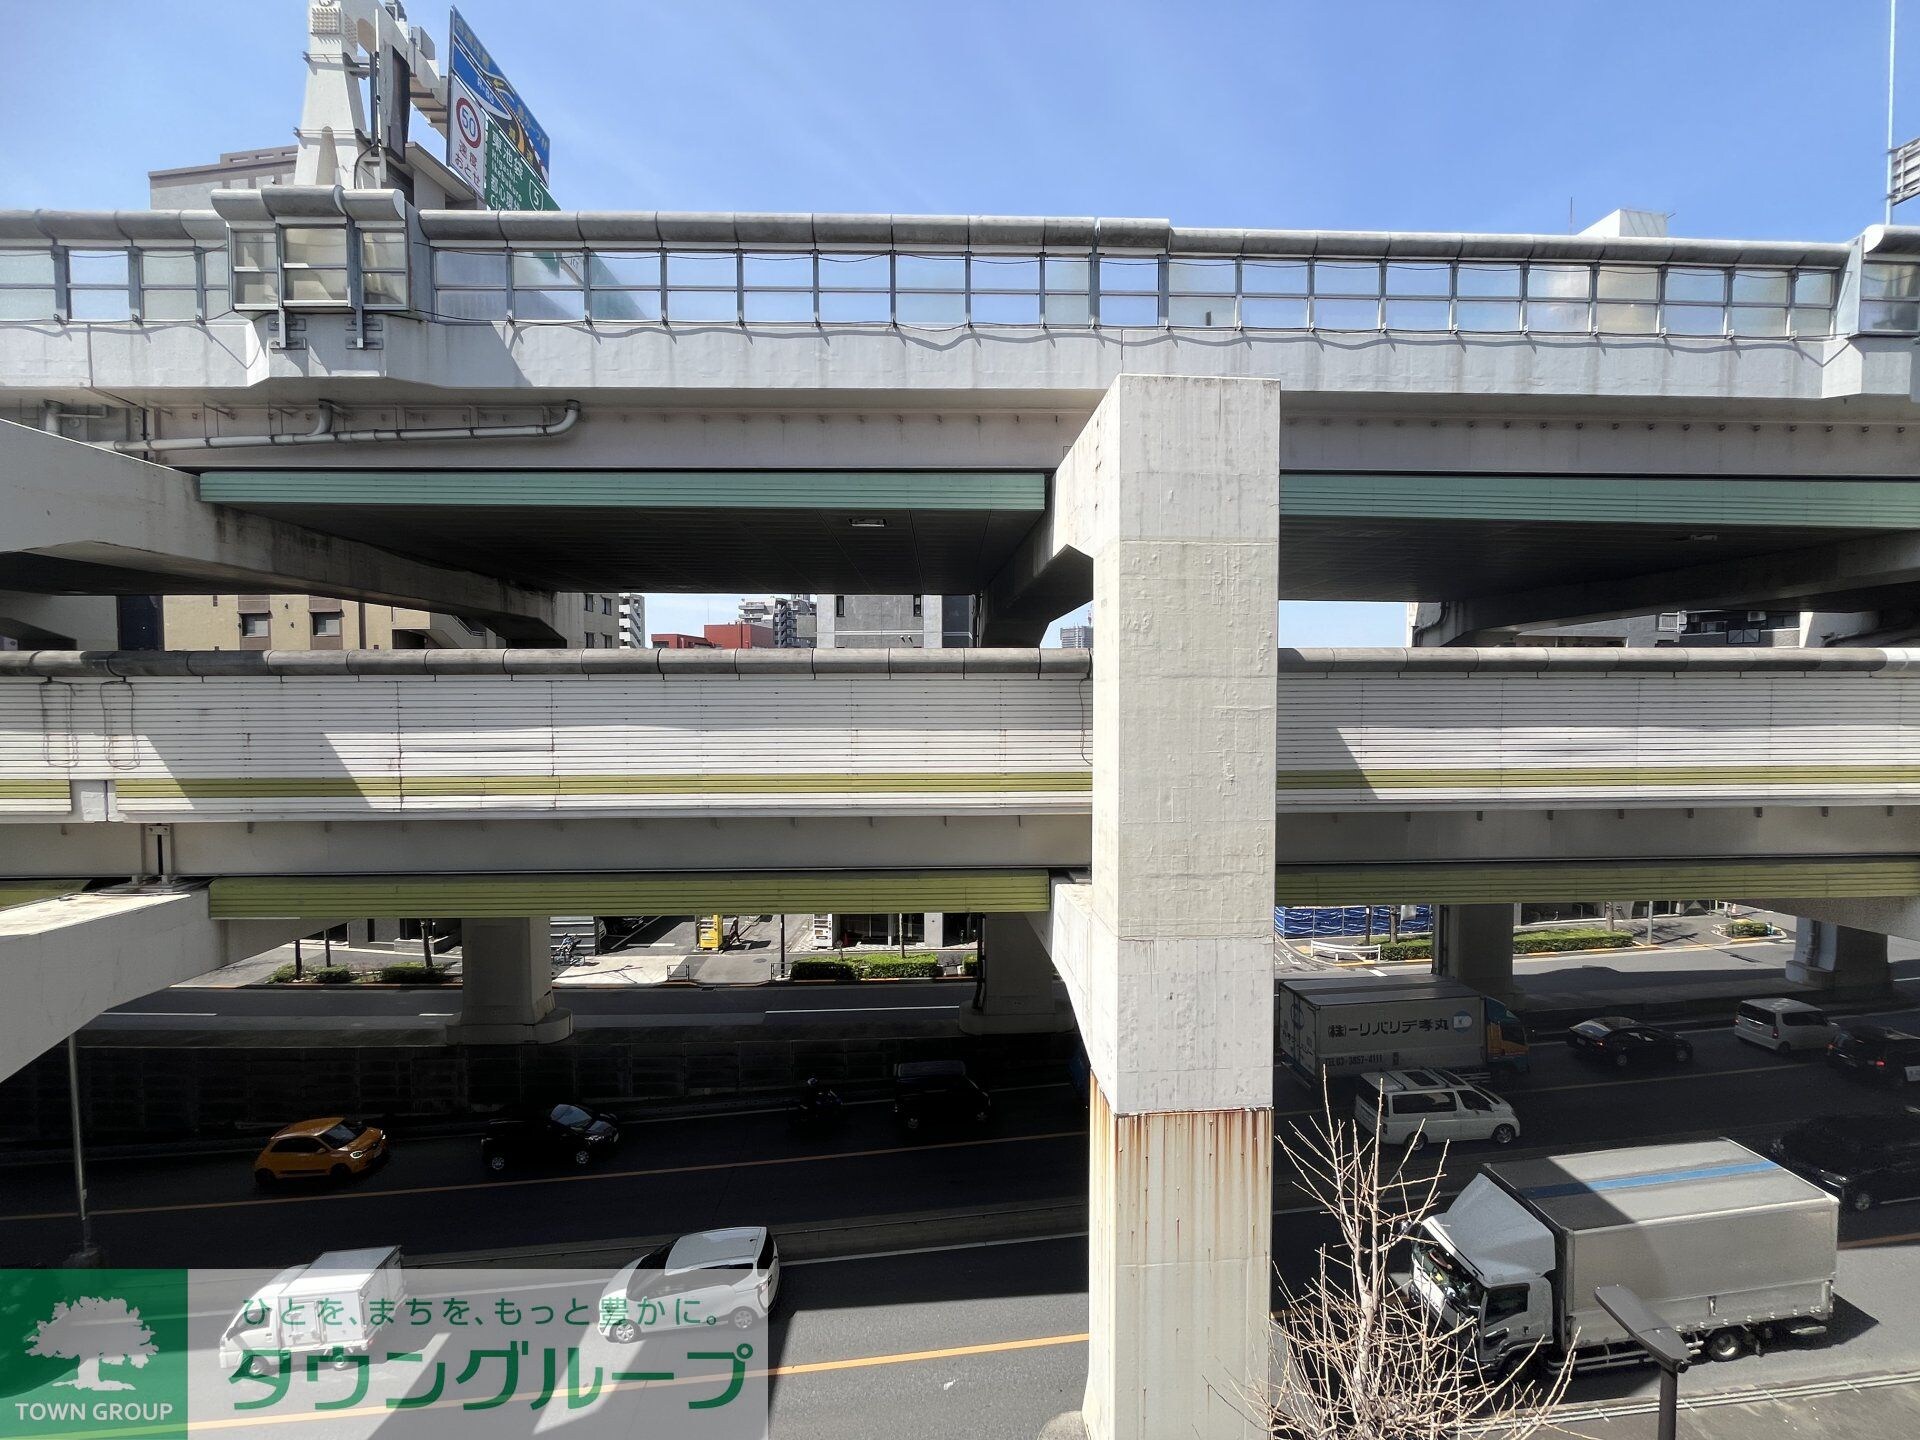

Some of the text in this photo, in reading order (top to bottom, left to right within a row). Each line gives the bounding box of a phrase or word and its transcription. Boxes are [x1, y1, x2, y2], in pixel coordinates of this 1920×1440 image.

[461, 107, 476, 138] 50
[455, 152, 481, 188] おとせ
[492, 129, 524, 181] 東池袋
